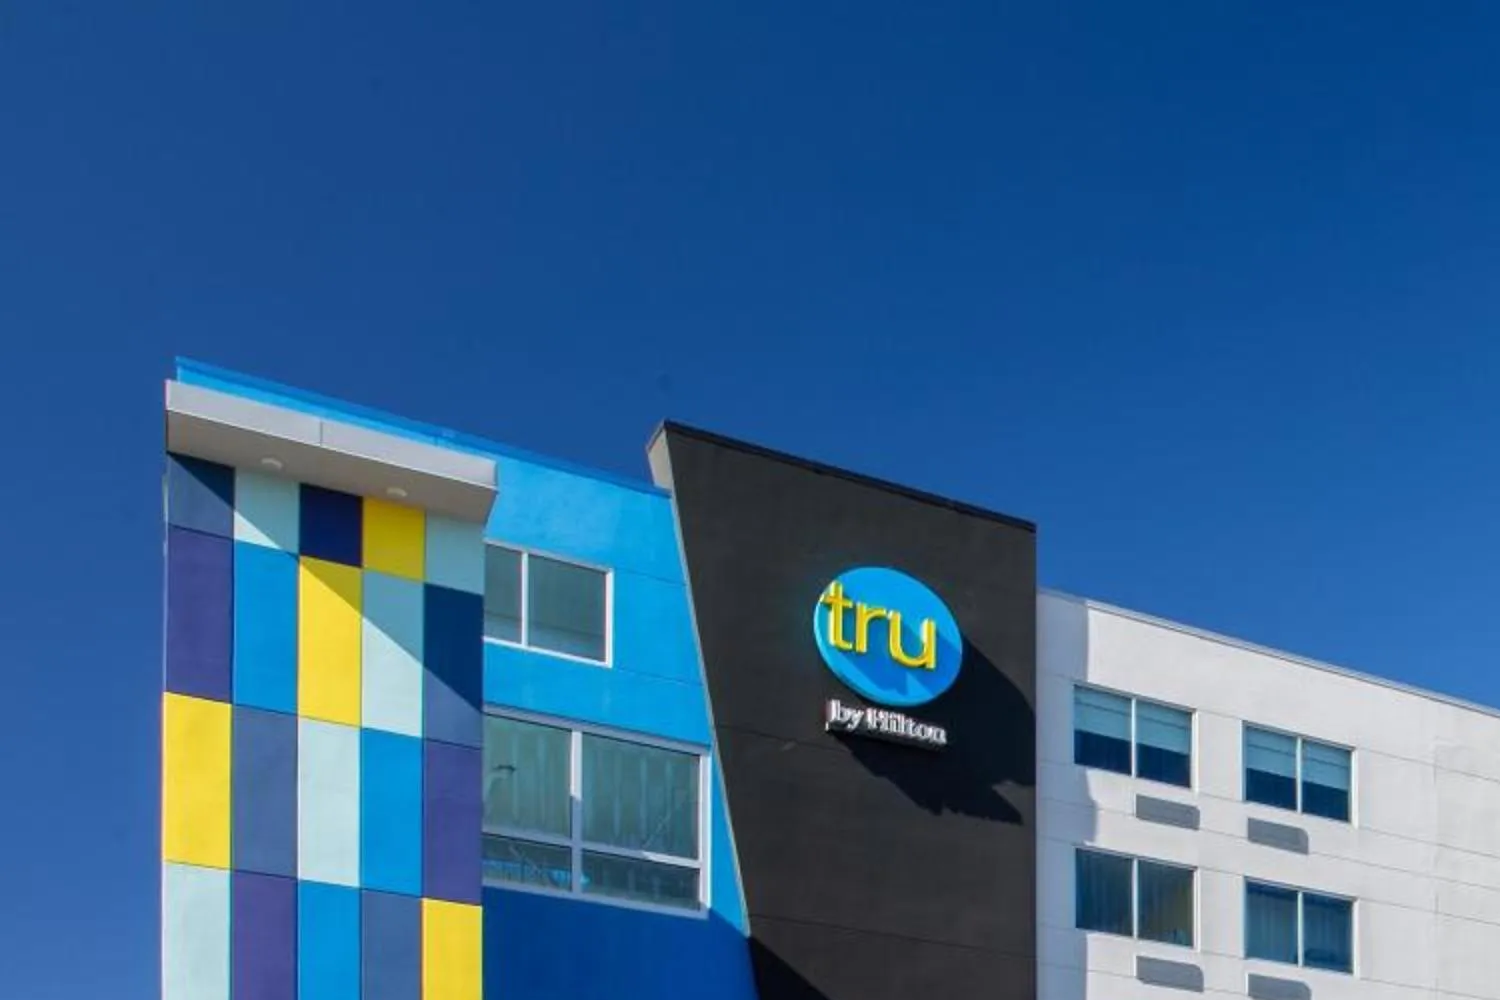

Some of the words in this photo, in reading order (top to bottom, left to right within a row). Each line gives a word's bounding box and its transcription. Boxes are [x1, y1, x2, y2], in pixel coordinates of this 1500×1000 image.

[819, 580, 937, 670] tru
[829, 699, 865, 732] by
[866, 707, 948, 745] Hilton
